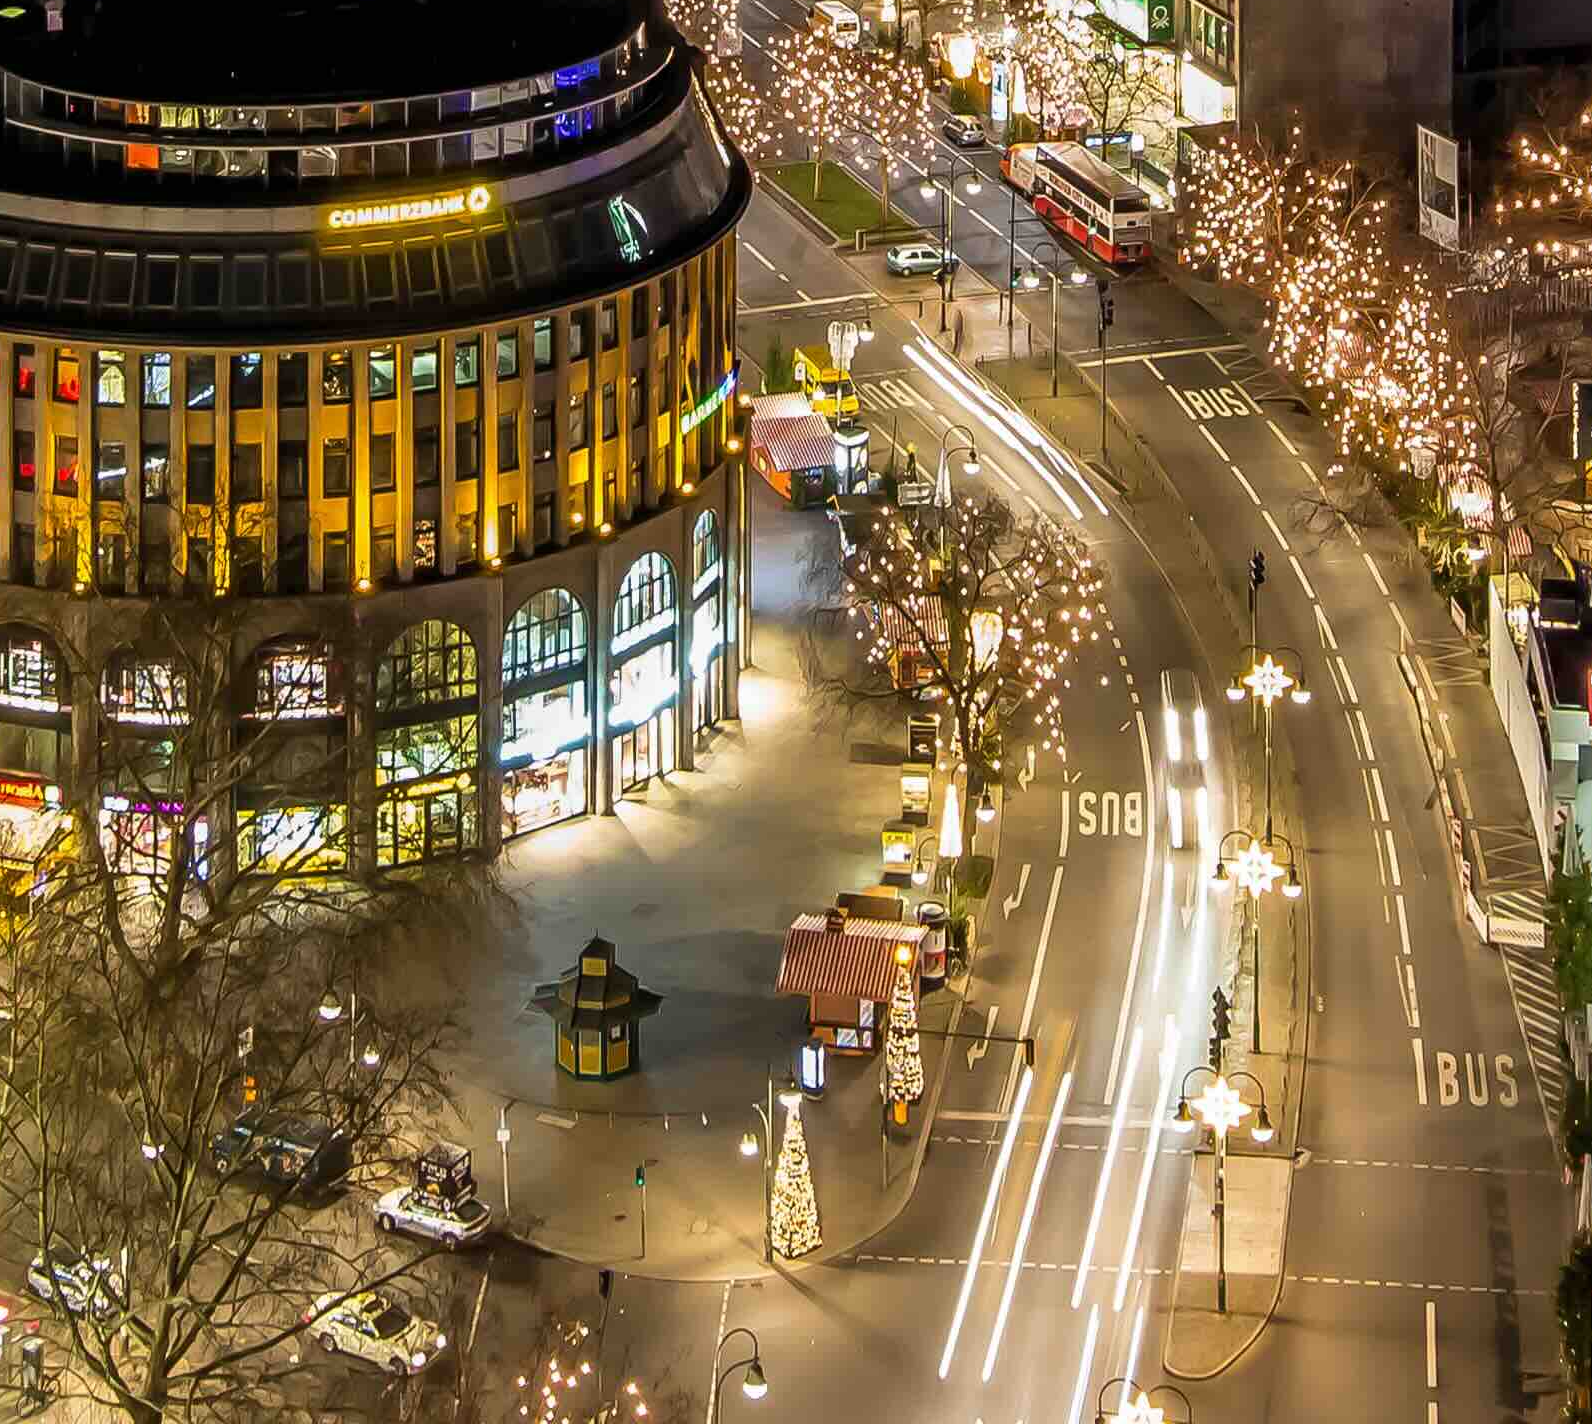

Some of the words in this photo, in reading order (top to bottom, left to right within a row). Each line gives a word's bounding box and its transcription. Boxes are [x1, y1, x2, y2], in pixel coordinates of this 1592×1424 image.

[329, 194, 465, 228] COMMERZBANK
[1182, 388, 1250, 420] BUS
[1078, 791, 1143, 836] BUS
[1436, 1052, 1519, 1107] BUS
